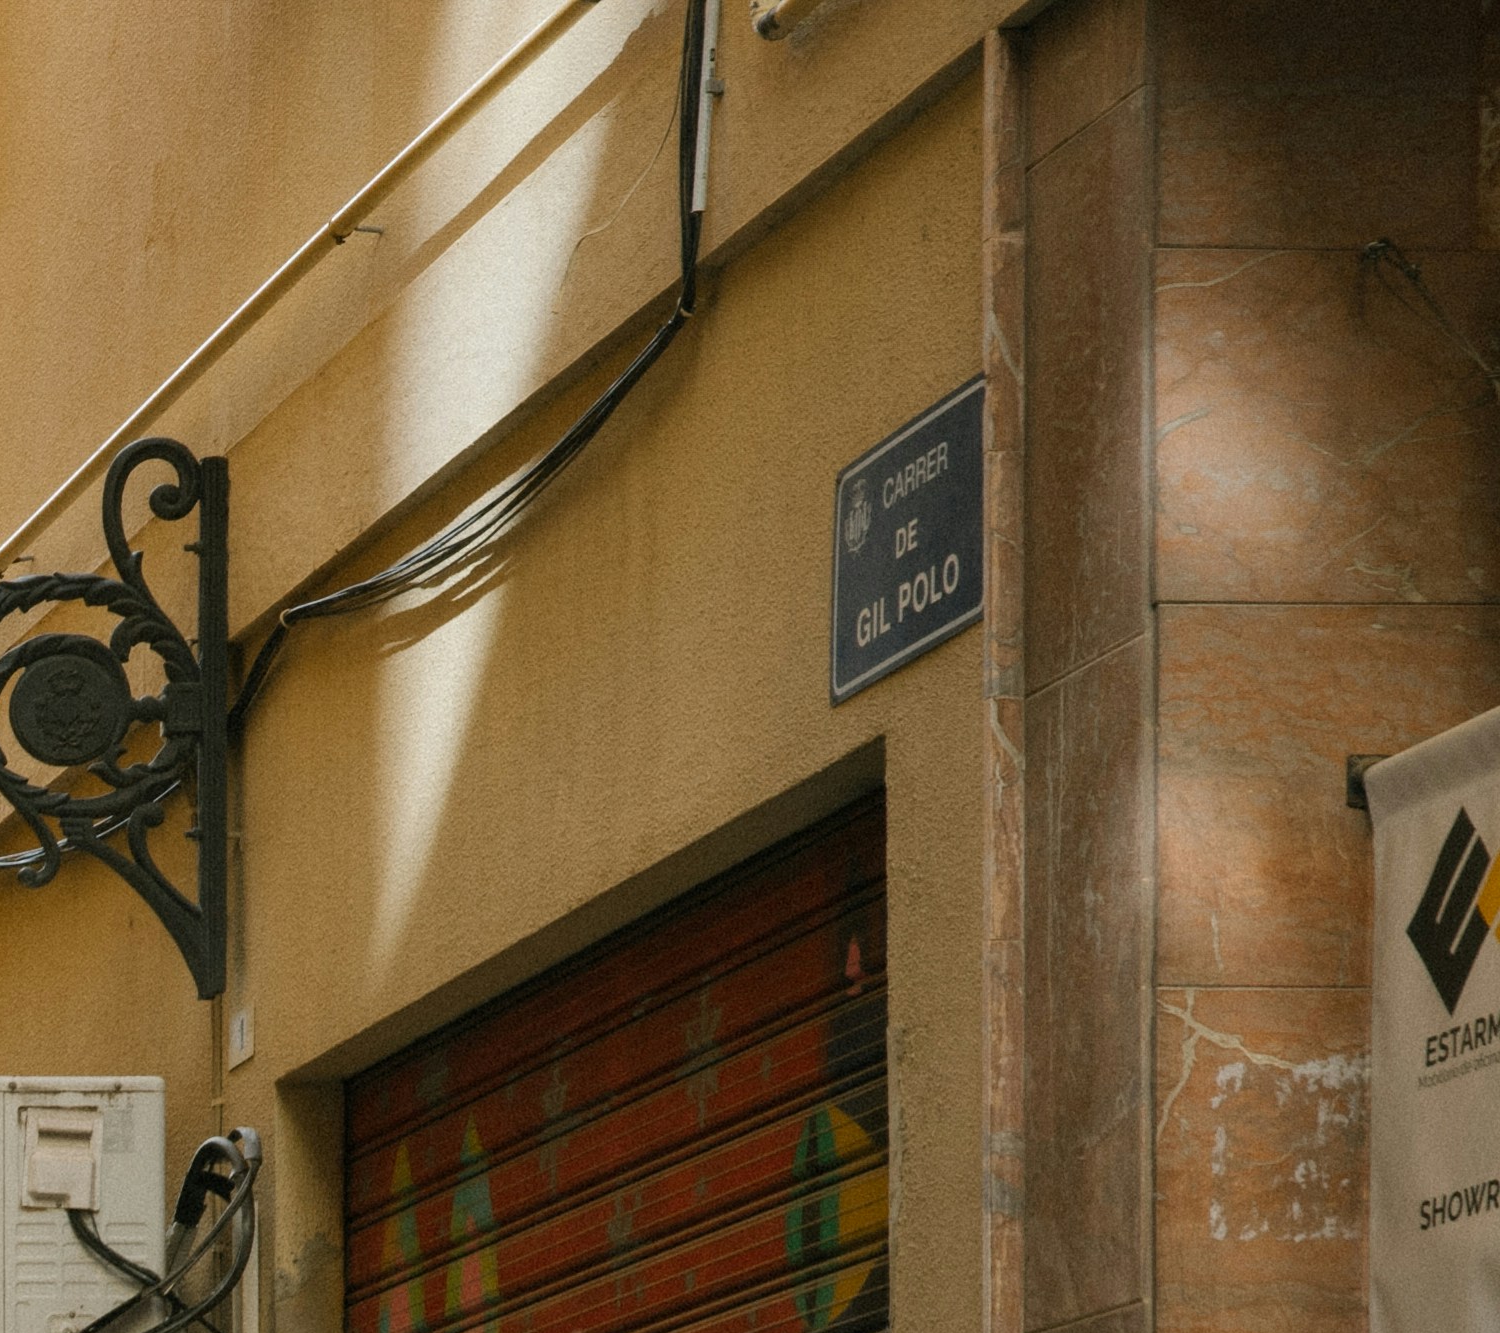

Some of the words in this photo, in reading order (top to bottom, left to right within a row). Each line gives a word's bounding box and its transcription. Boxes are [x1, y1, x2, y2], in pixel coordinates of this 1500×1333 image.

[883, 441, 948, 509] CARRER
[896, 518, 918, 558] DE
[857, 597, 891, 647] GIL
[899, 554, 959, 623] POLO
